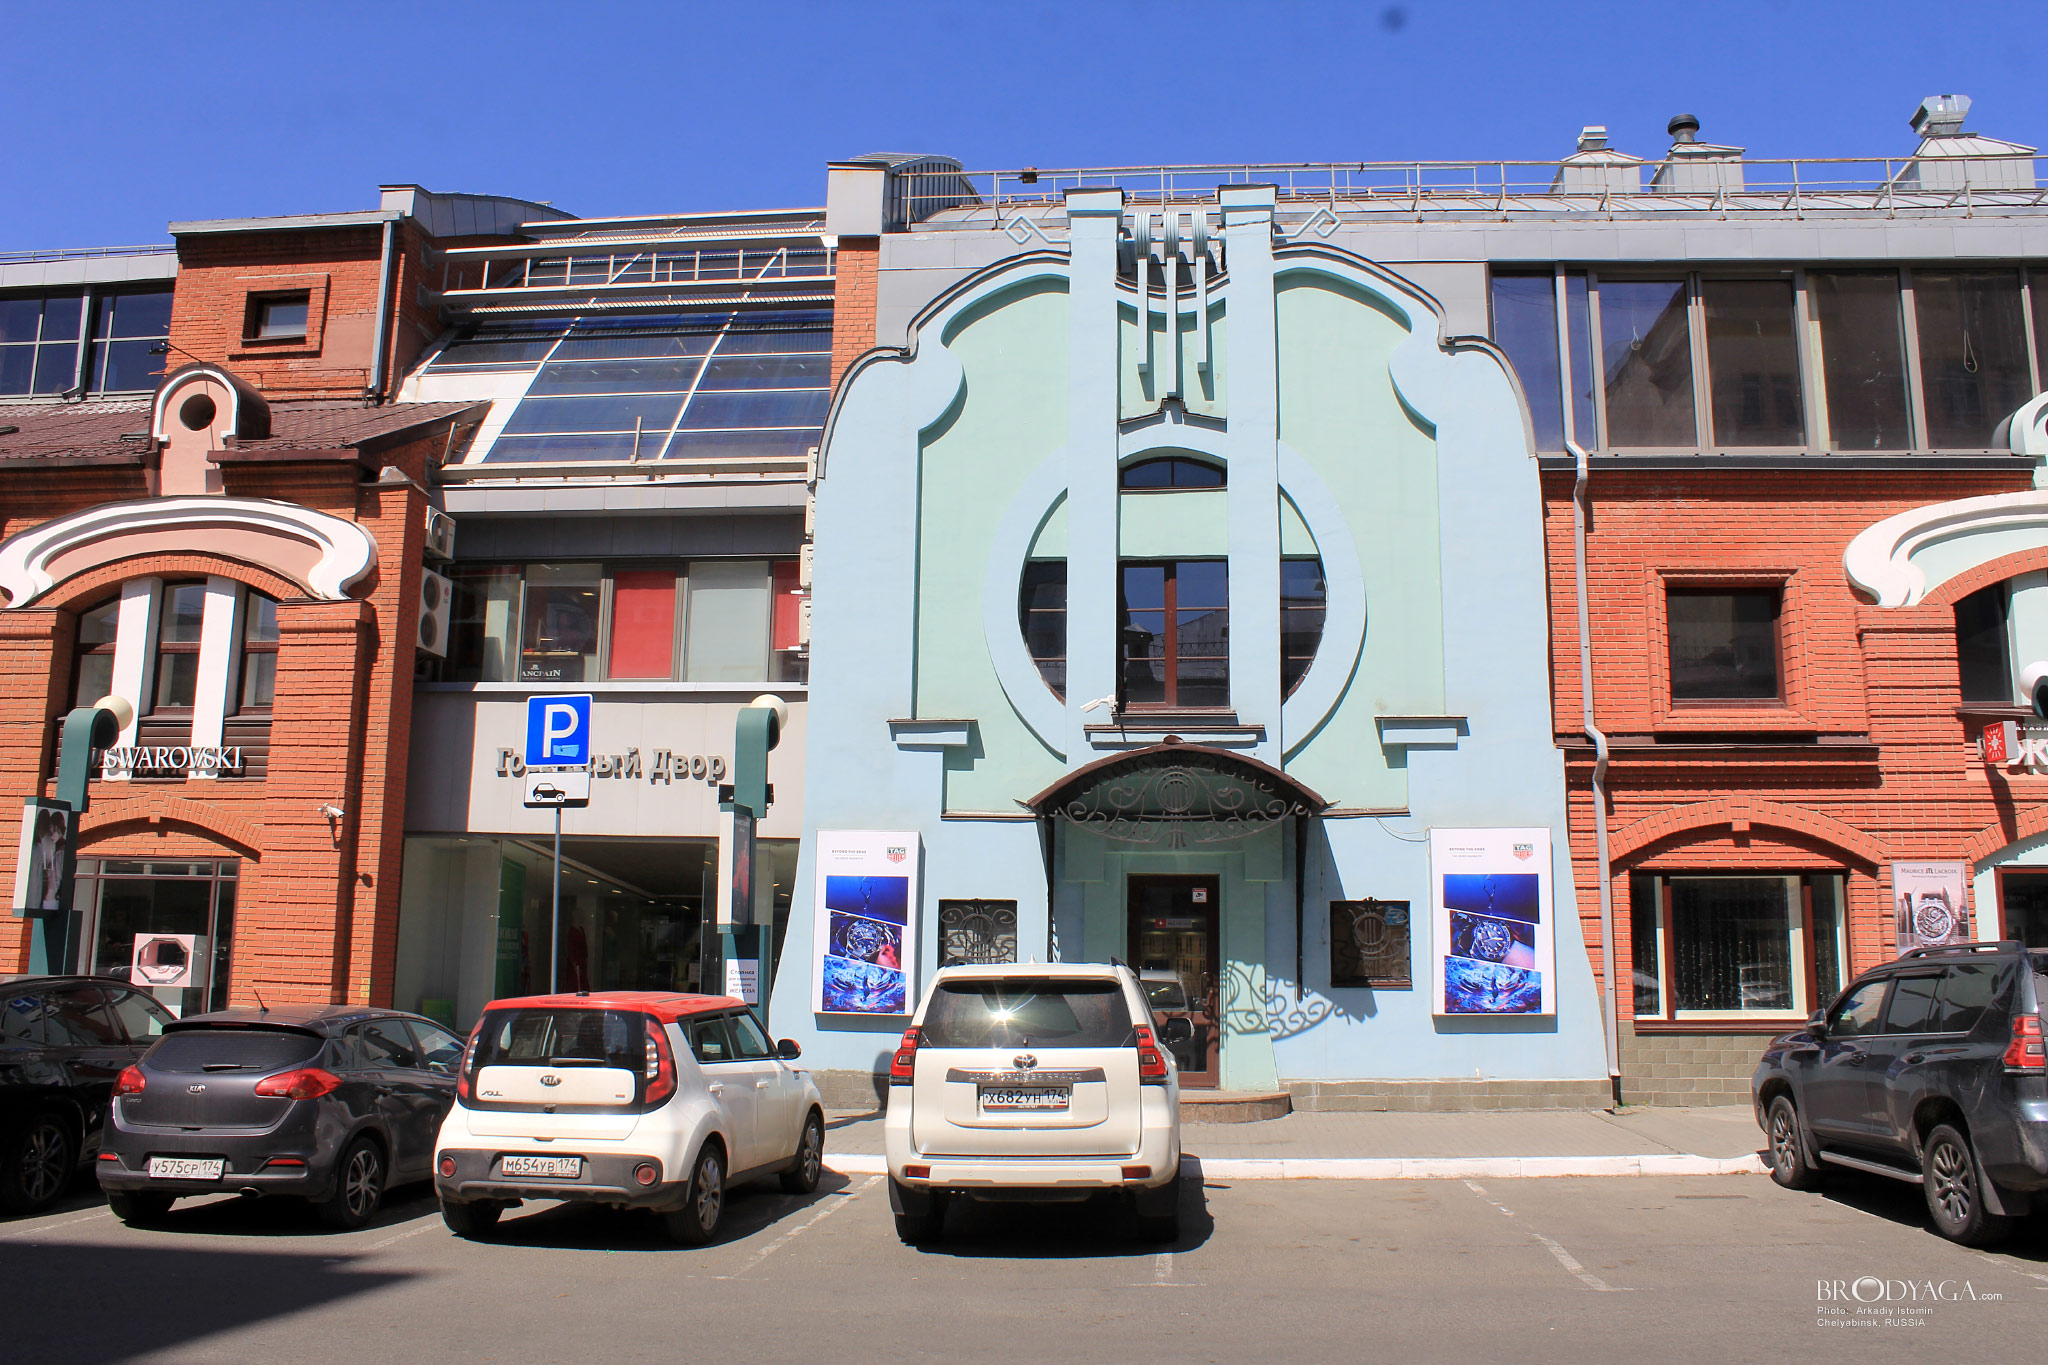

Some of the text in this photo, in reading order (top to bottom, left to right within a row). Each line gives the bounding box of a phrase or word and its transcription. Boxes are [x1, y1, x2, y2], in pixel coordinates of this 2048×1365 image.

[543, 703, 579, 758] P
[104, 746, 242, 769] SWAROVSKI
[496, 746, 726, 787] Гоый Двор
[543, 1075, 559, 1085] KIA
[988, 1089, 1064, 1104] Х682УН 174
[154, 1160, 221, 1174] У575СР 174
[506, 1158, 577, 1171] М654УВ 174
